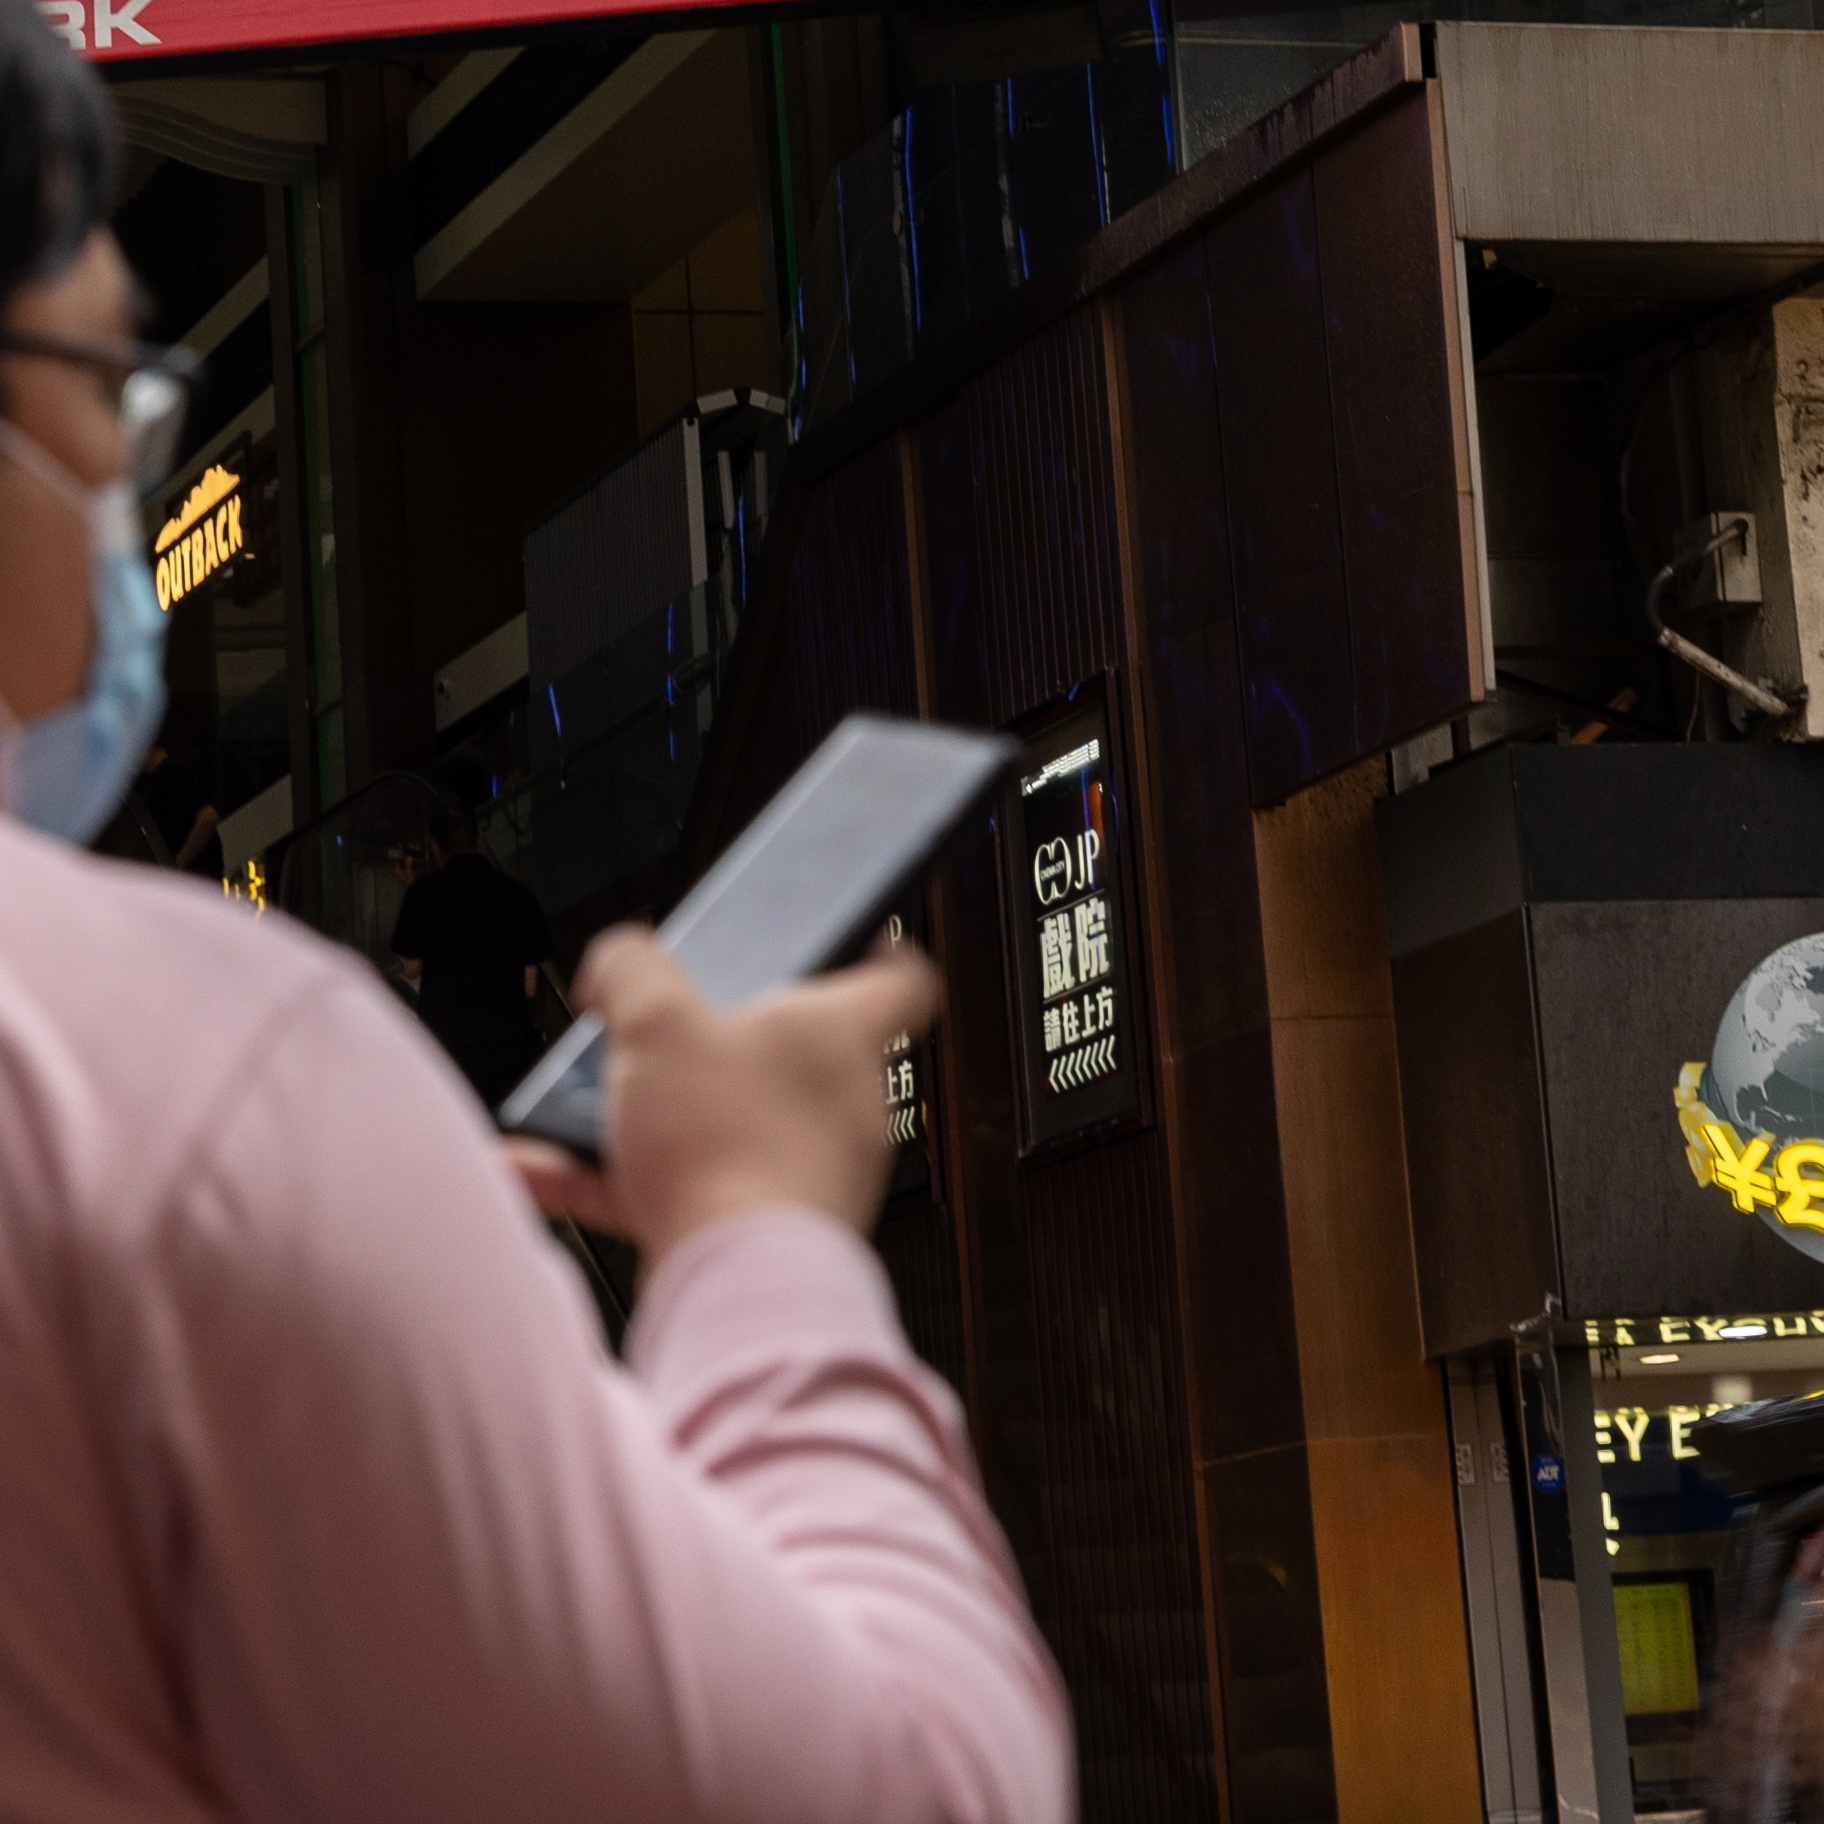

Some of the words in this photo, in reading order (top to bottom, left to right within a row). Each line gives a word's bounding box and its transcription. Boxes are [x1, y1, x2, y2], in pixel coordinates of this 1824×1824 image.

[156, 494, 243, 612] OUTBACK
[1074, 828, 1100, 890] JP
[1040, 897, 1110, 999] 戲院
[1043, 985, 1114, 1054] 請往上方
